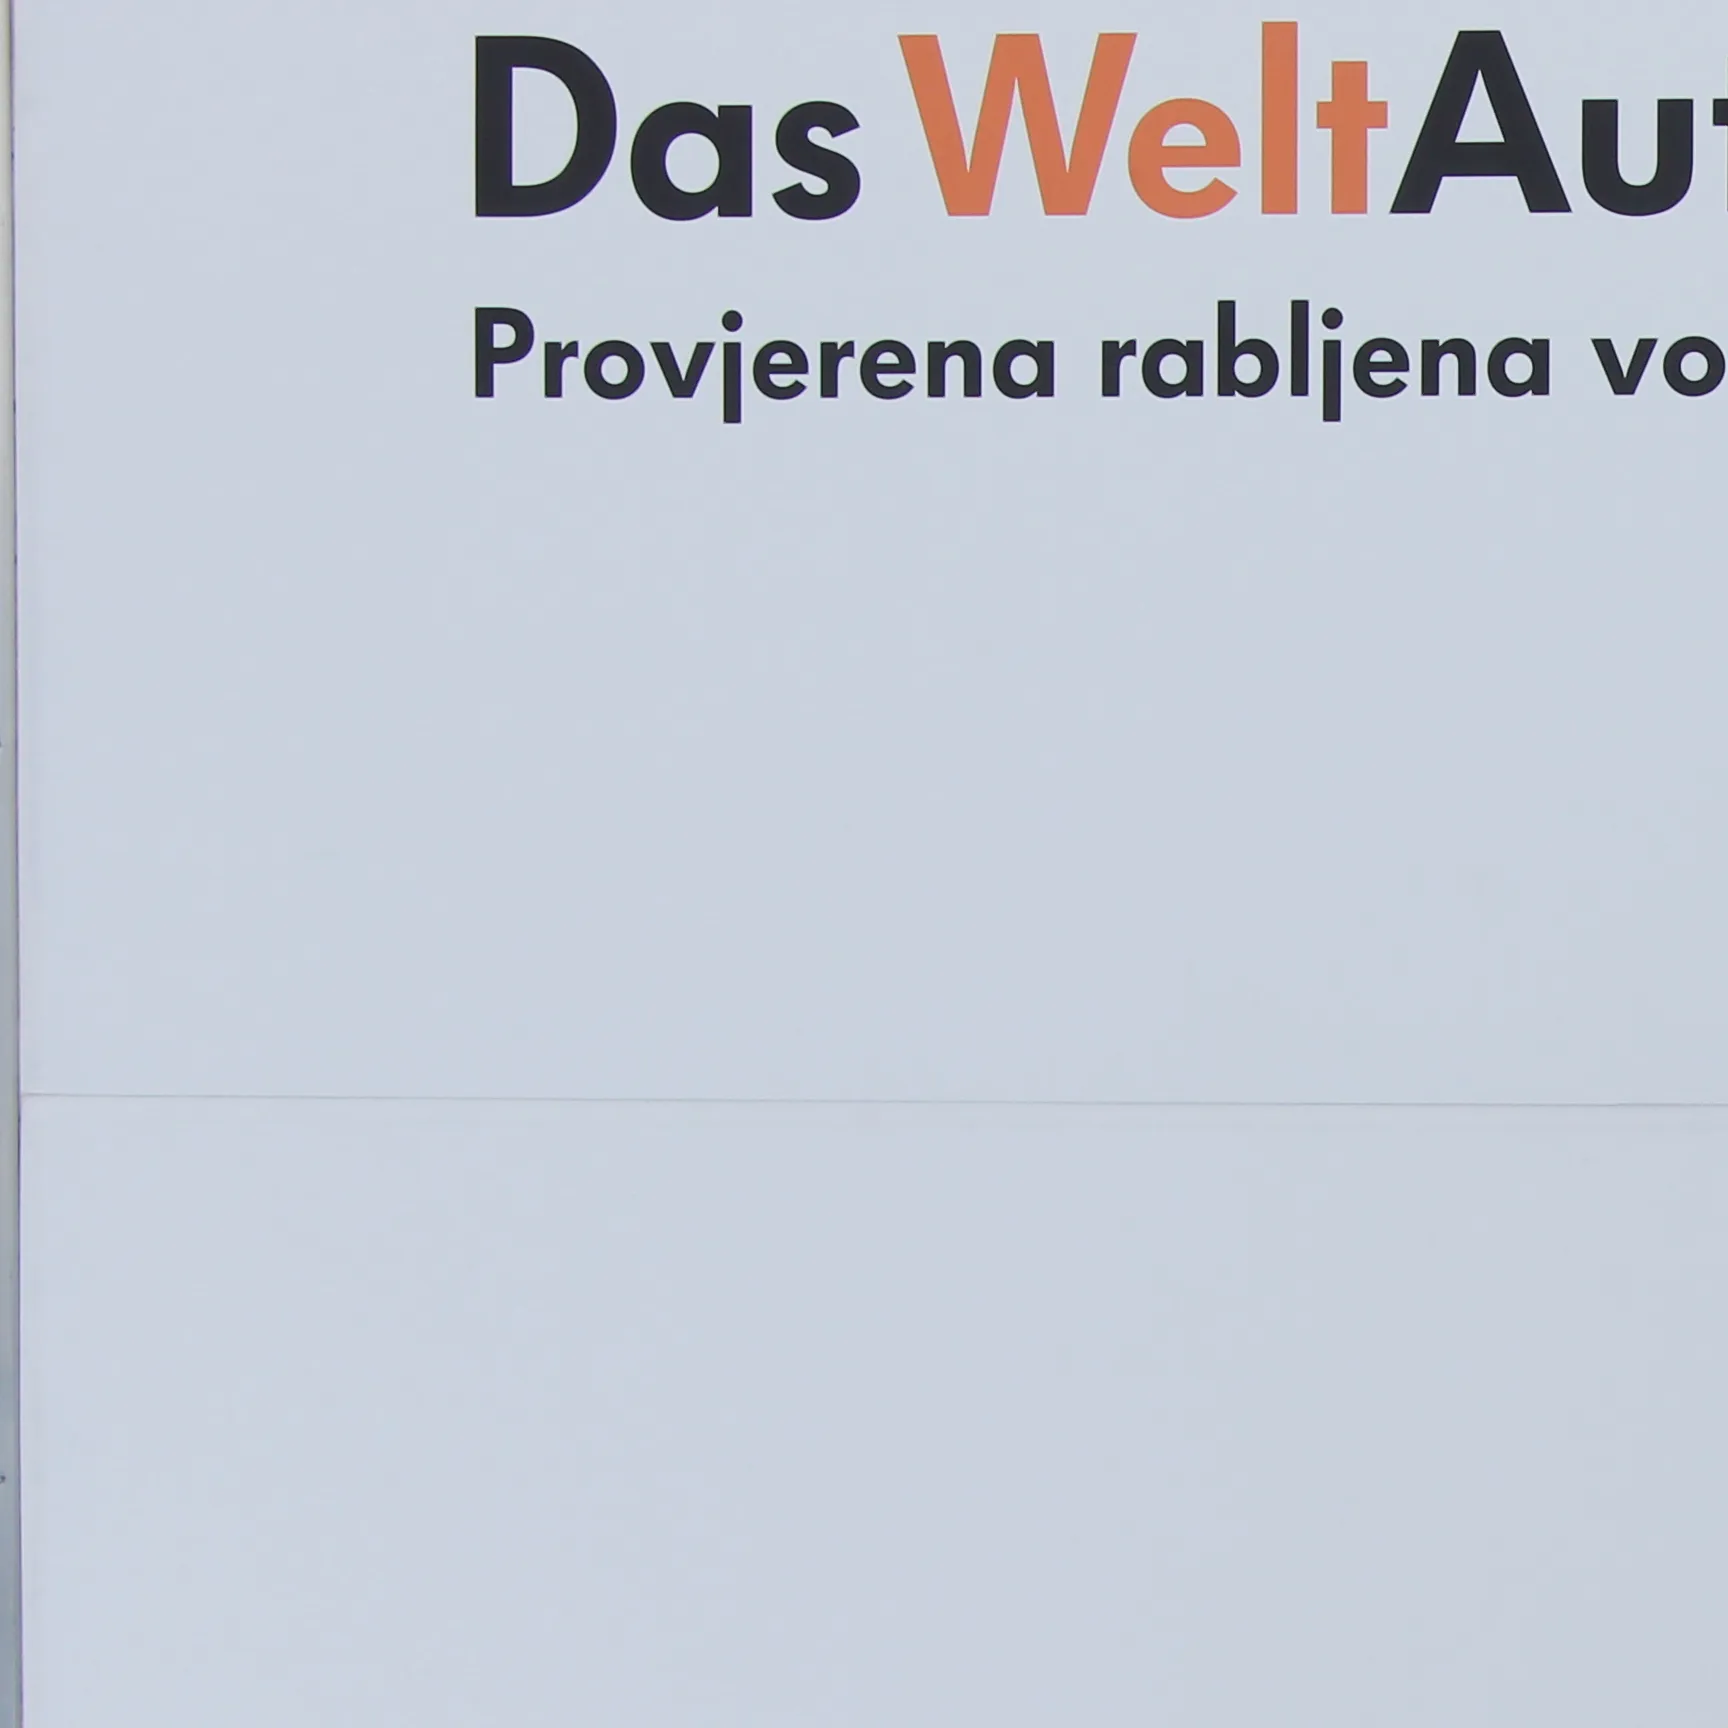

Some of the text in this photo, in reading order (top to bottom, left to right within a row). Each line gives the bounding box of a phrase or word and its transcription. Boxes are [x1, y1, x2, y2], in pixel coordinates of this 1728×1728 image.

[474, 35, 861, 222] Das
[474, 306, 1055, 424] Provjerena
[1101, 299, 1550, 423] rabljena
